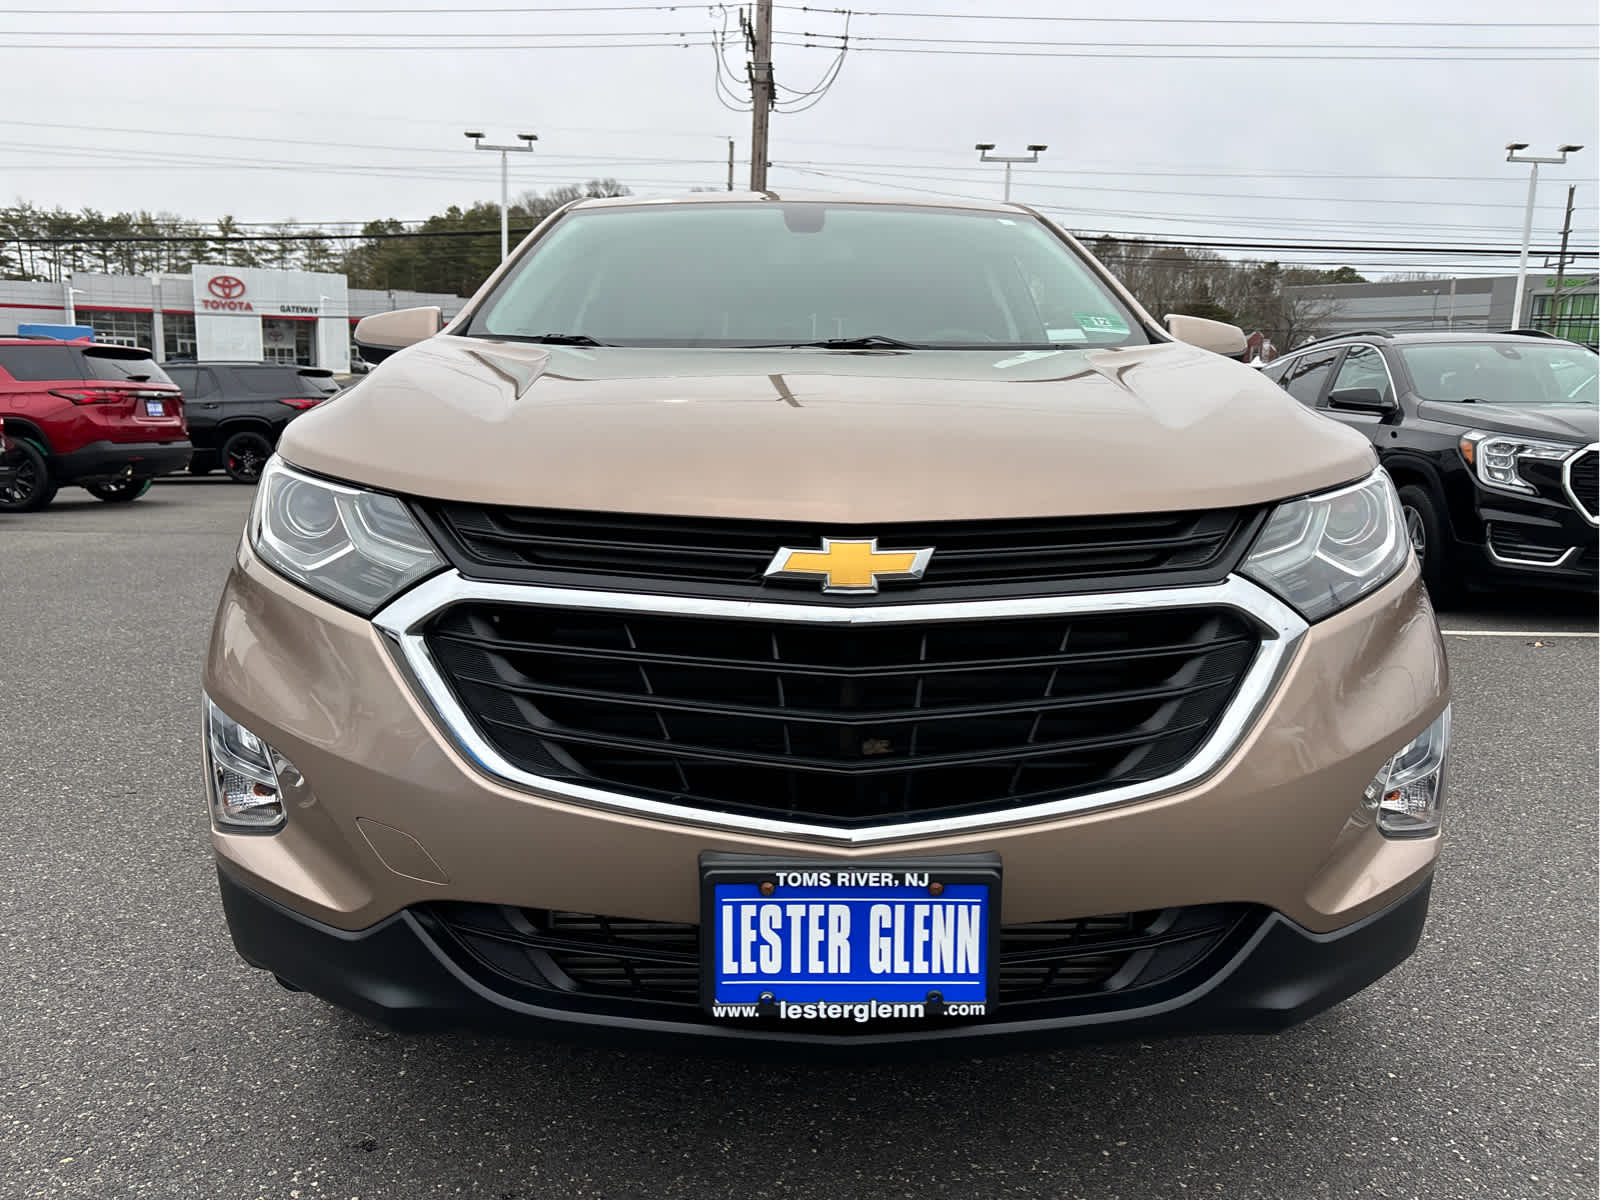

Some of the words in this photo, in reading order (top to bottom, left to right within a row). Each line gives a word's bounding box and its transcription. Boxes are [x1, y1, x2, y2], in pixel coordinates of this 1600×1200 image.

[202, 299, 253, 312] TOYOTA
[280, 304, 319, 314] GATEWAY
[776, 872, 831, 887] TOMS
[837, 872, 899, 888] RIVER,
[905, 872, 929, 887] NJ
[722, 904, 851, 975] LESTER
[869, 903, 981, 975] GLENN
[712, 1005, 759, 1018] www.
[780, 1000, 925, 1023] lesterglenn
[943, 1002, 986, 1016] .com
